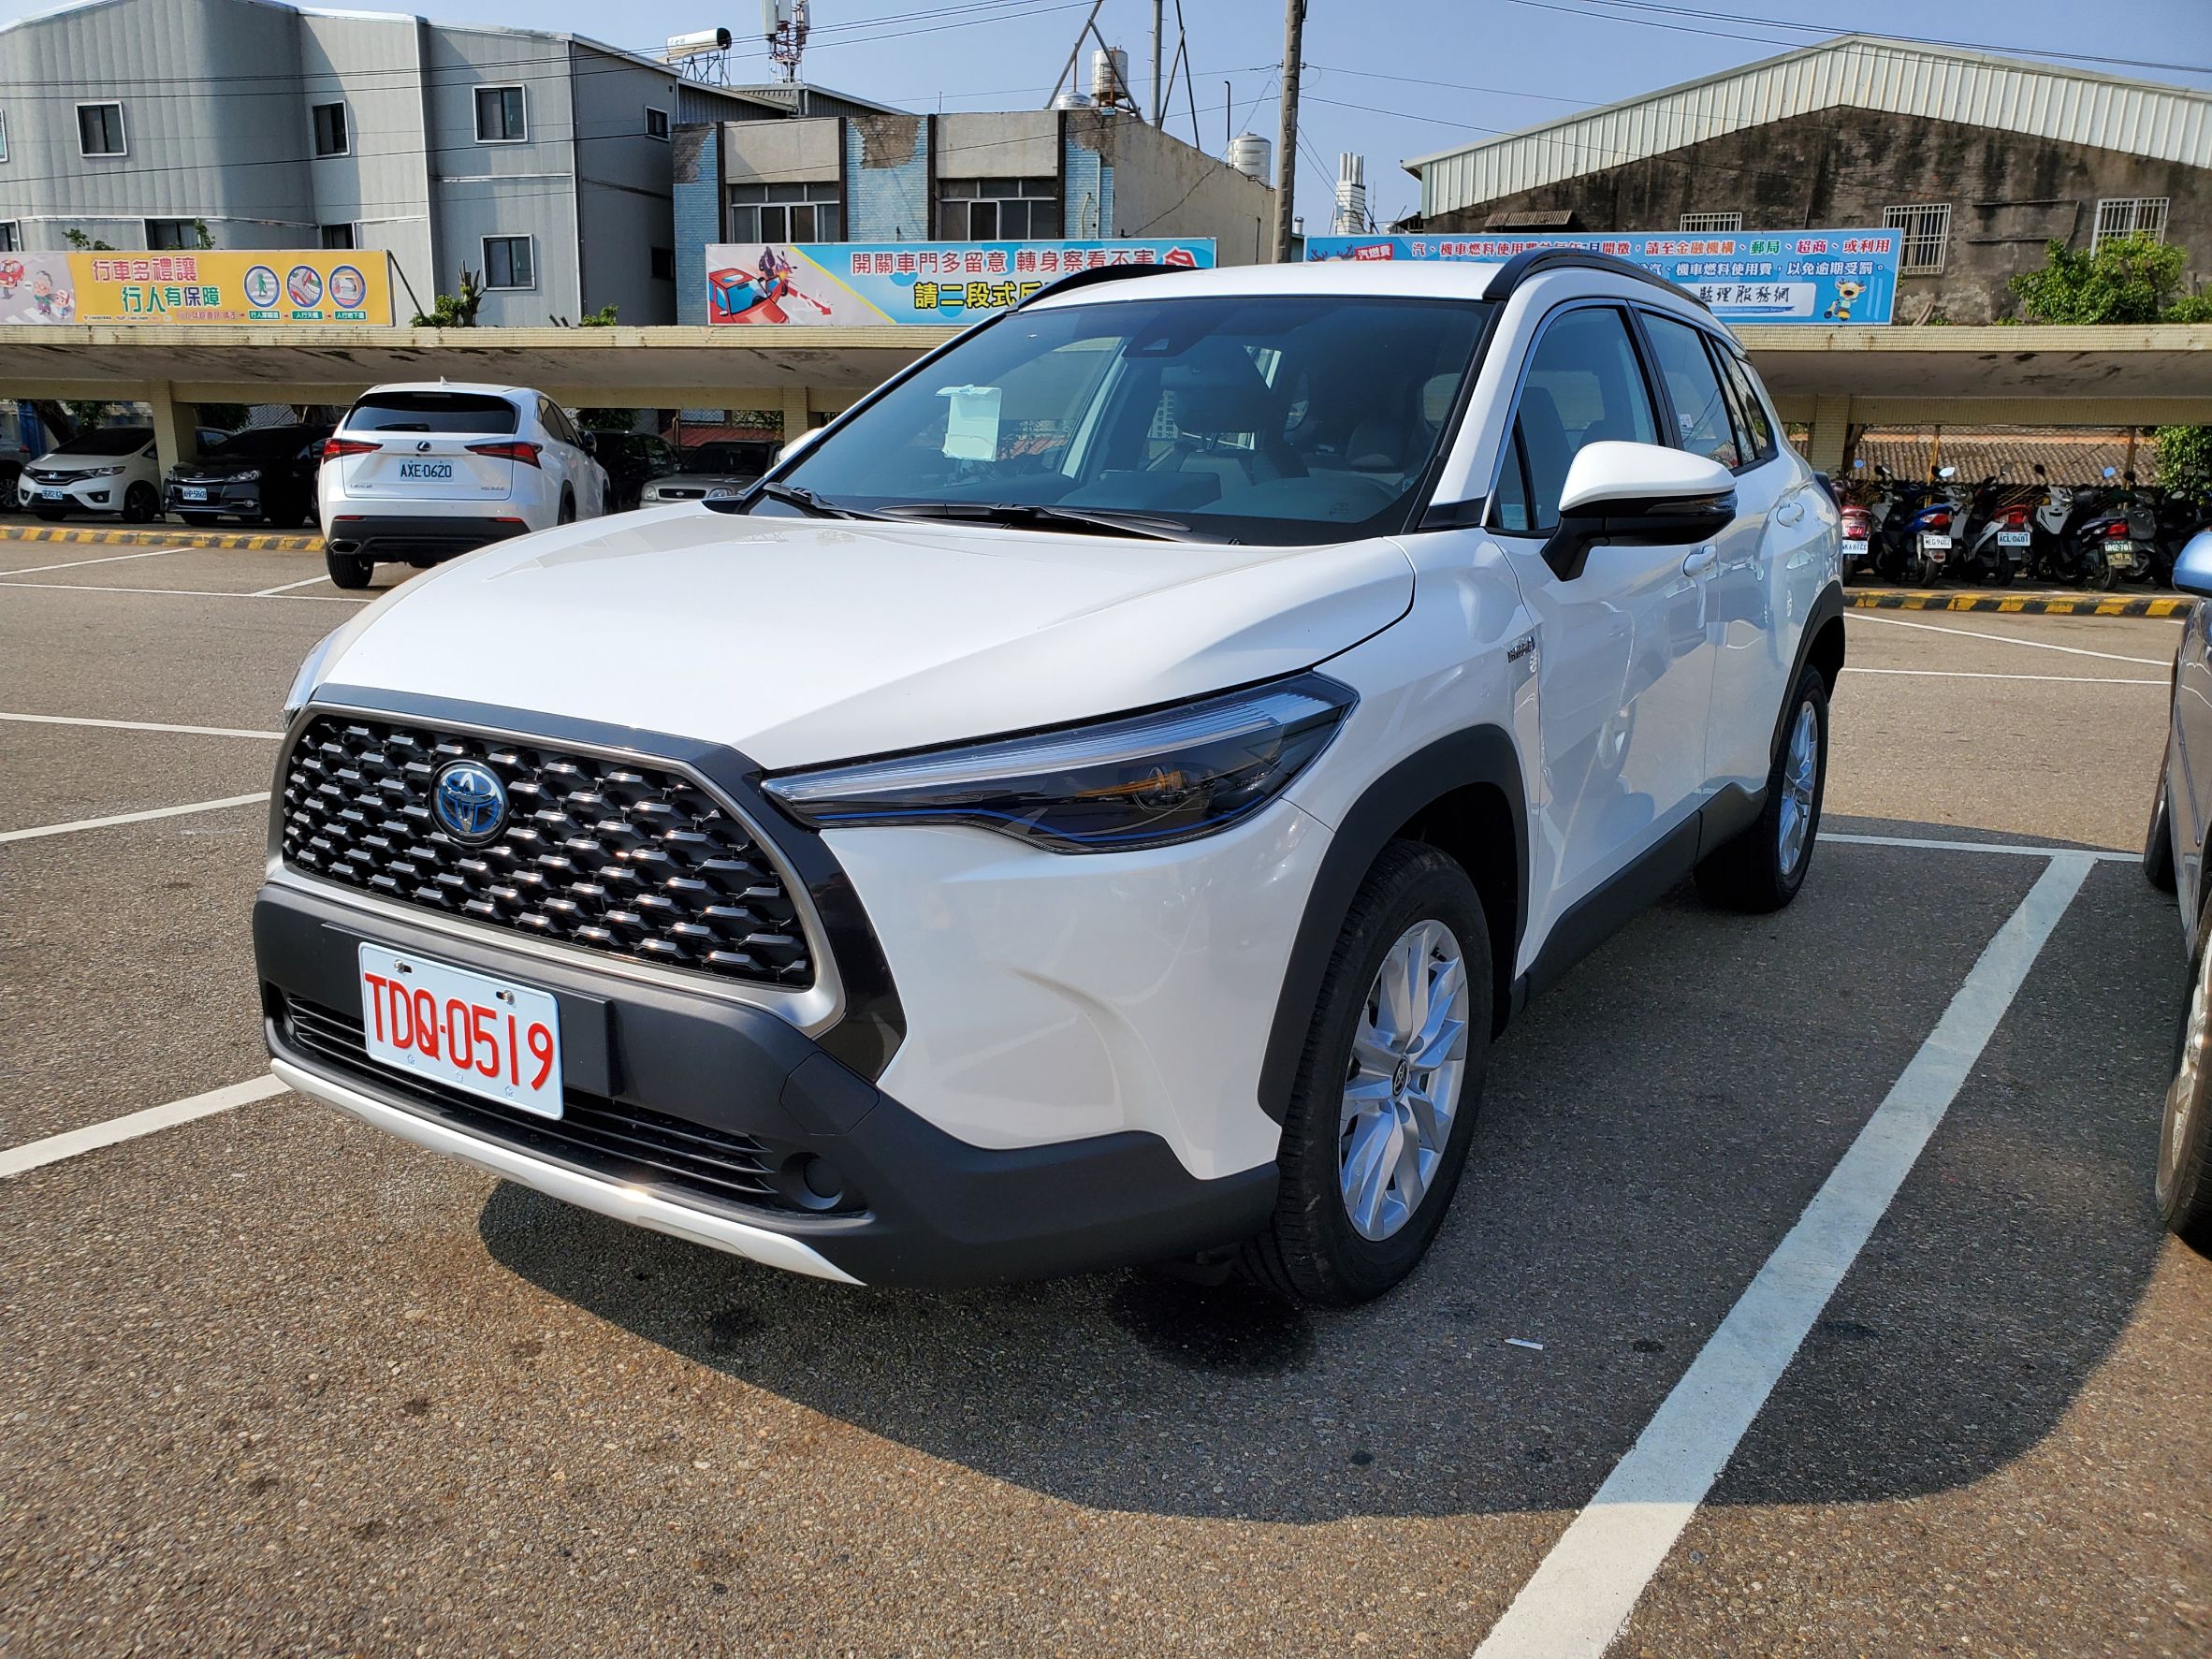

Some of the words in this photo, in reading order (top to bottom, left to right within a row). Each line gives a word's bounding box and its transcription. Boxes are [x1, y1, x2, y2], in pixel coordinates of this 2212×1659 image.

[93, 256, 197, 282] 行車多禮讓
[851, 253, 1006, 274] 開關車門多留意
[122, 286, 221, 313] 行人有保障
[400, 464, 453, 478] AXE-0620
[365, 973, 554, 1091] TDQ-0519
